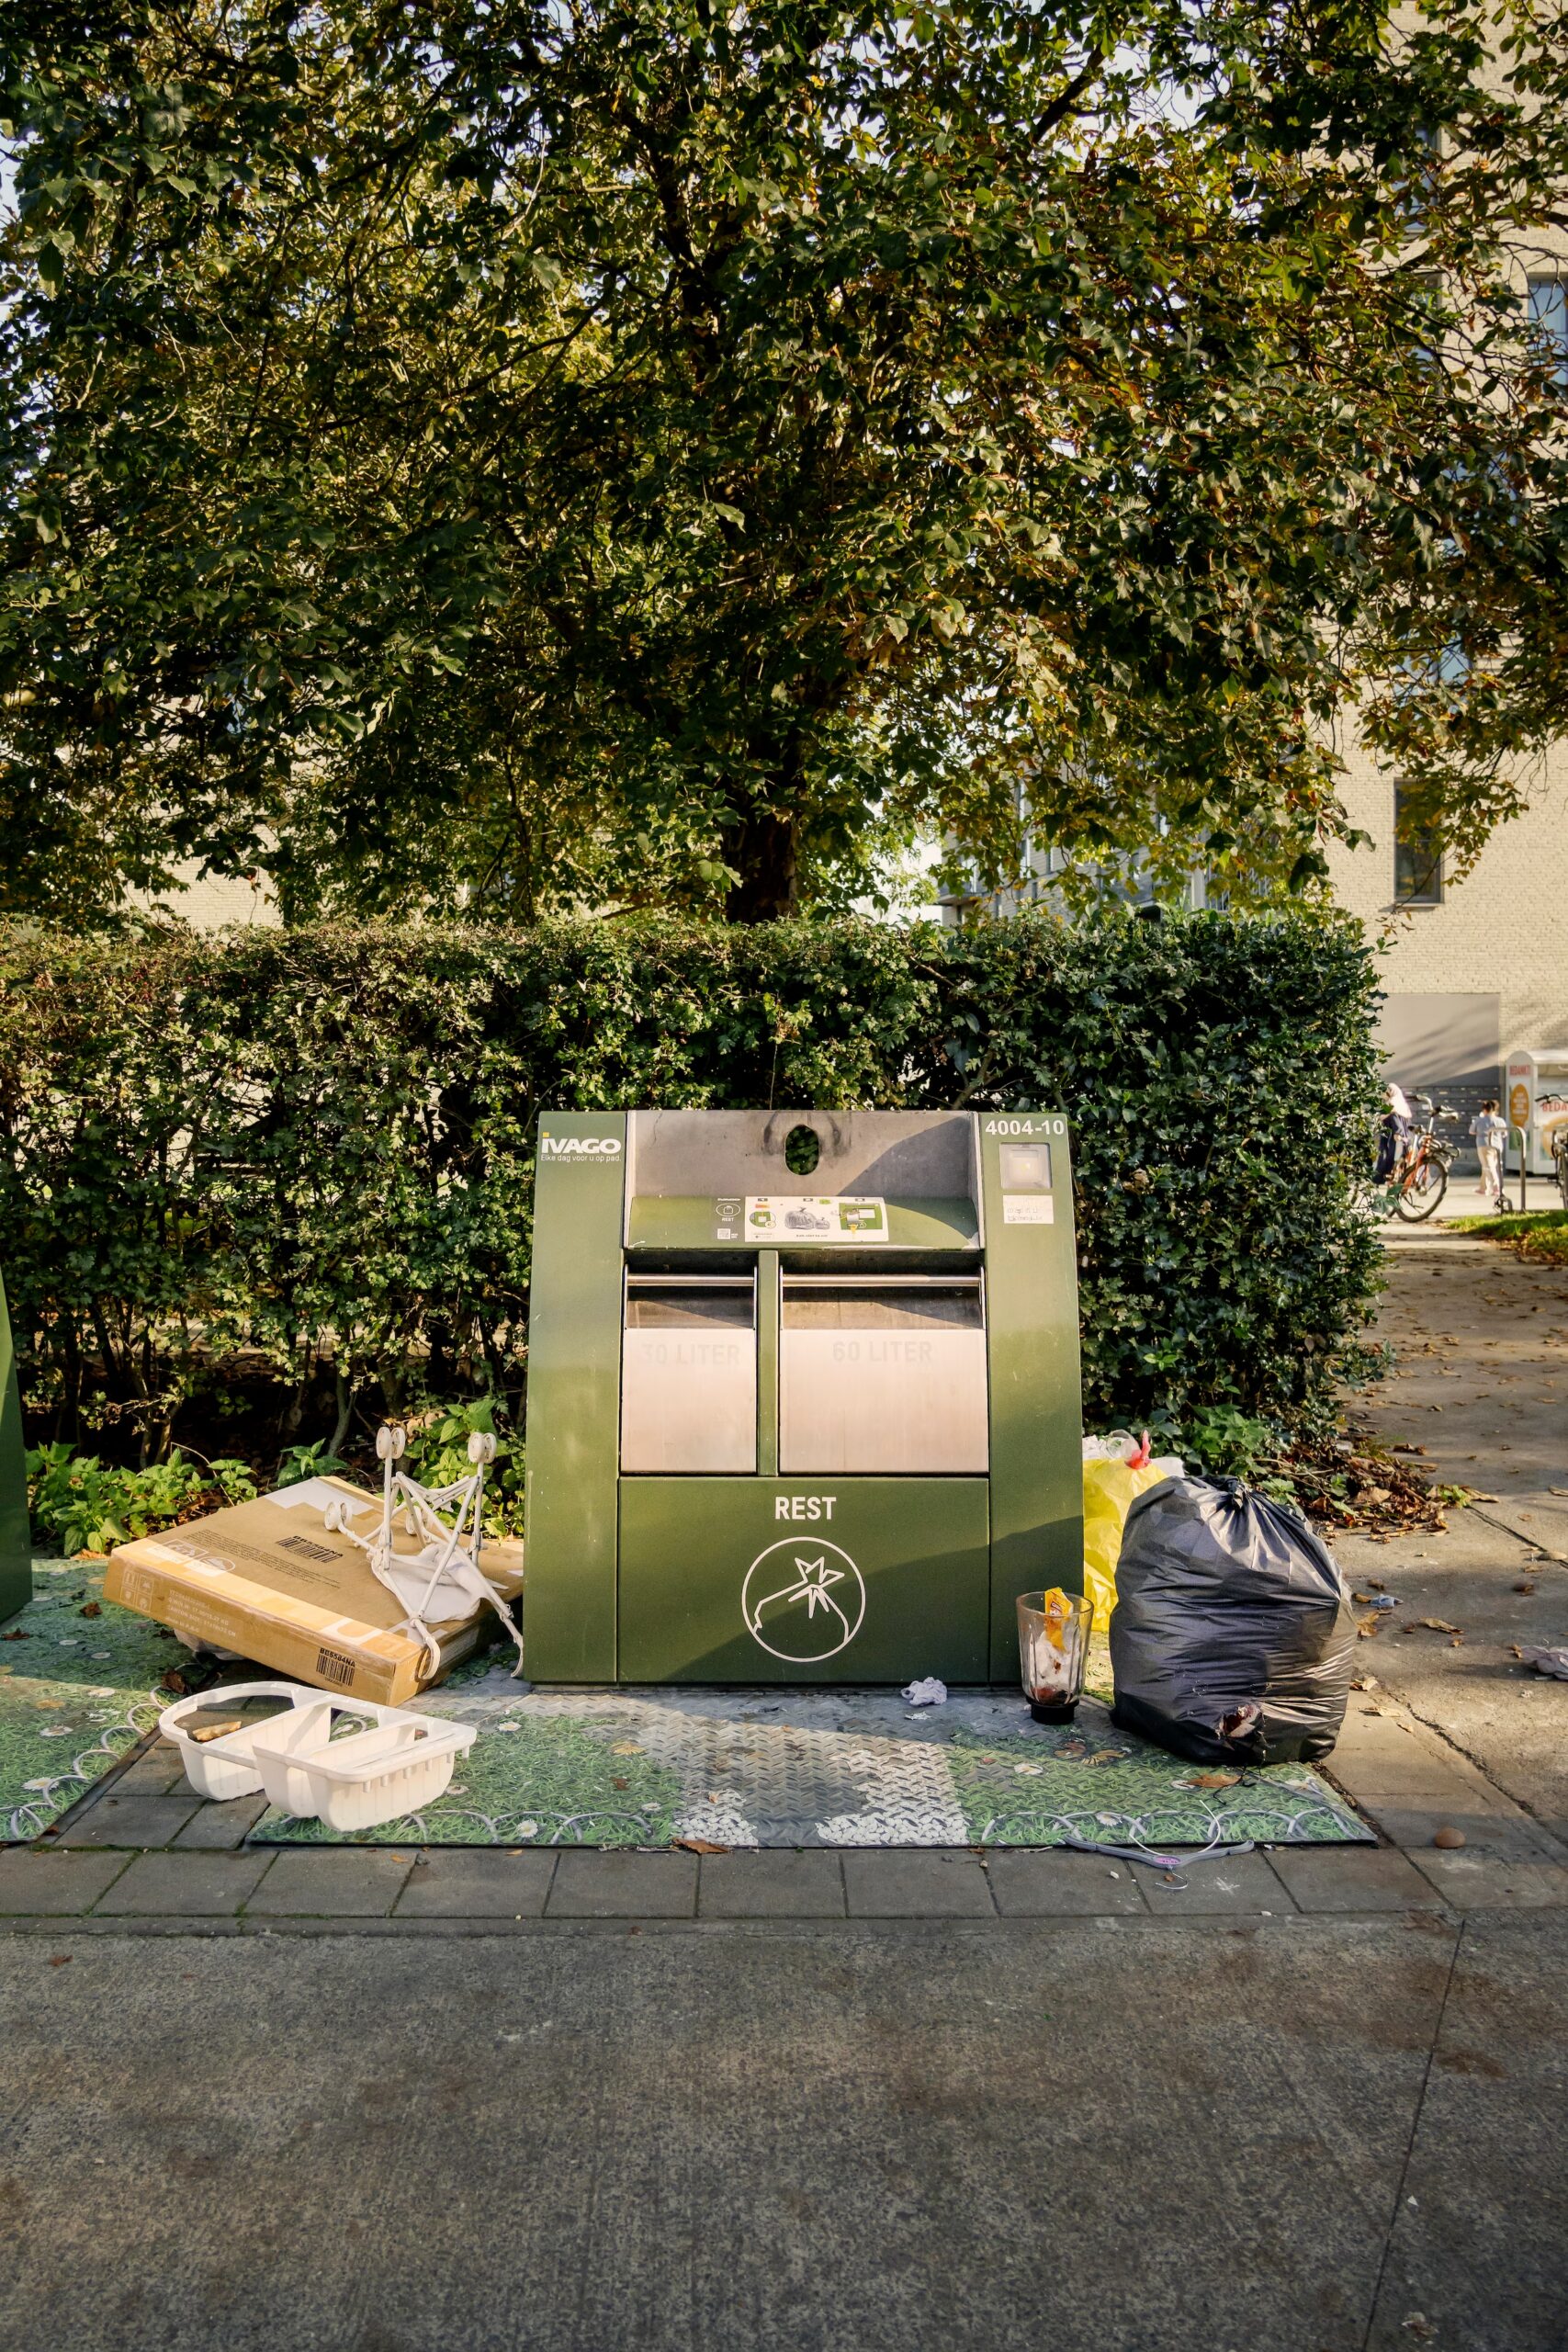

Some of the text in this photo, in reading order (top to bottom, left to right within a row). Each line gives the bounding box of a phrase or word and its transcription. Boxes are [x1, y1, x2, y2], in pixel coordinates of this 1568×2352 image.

[985, 1119, 1065, 1136] 4004-10
[557, 1154, 571, 1163] dag
[595, 1155, 604, 1163] op
[605, 1154, 622, 1164] pad.
[676, 1342, 741, 1366] LITER
[831, 1340, 933, 1363] 60 LITER
[774, 1496, 837, 1521] REST
